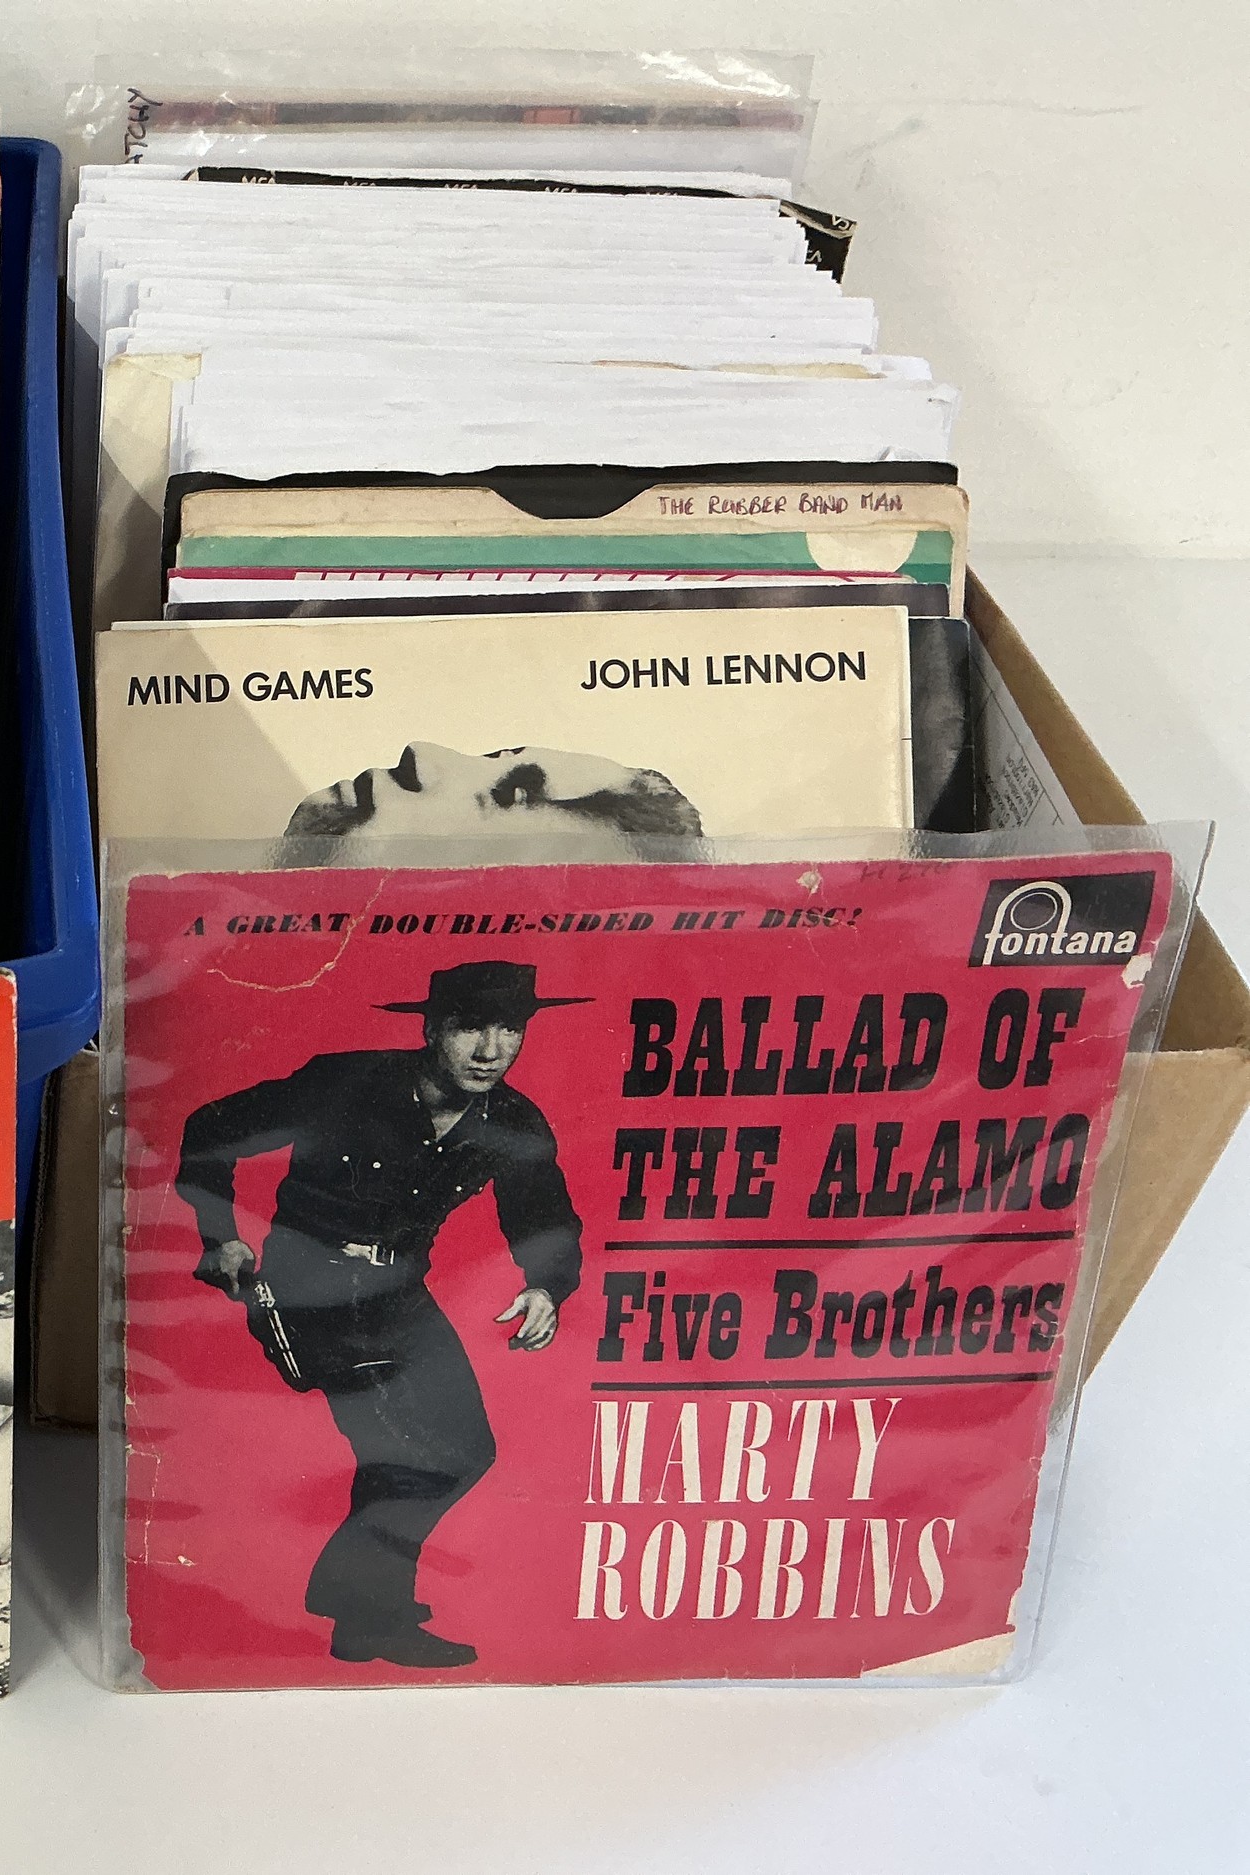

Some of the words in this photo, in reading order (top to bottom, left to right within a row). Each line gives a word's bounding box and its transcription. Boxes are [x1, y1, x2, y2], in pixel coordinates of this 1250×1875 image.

[657, 496, 694, 515] THE
[708, 494, 787, 515] RUBBER
[798, 492, 848, 514] BAND
[860, 491, 903, 512] MAN
[127, 674, 230, 708] MIND
[241, 667, 374, 702] GAMES
[580, 657, 690, 691] JOHN
[705, 650, 867, 686] LENNON
[183, 914, 206, 937] A
[226, 911, 350, 935] GREAT
[368, 907, 656, 936] DOUBLE-SIDED
[671, 909, 745, 932] HIT
[757, 906, 863, 930] DISC!
[622, 992, 949, 1098] BALLAD
[977, 987, 1086, 1090] OF
[612, 1125, 782, 1221] THE
[807, 1112, 1092, 1220] ALAMO
[596, 1271, 744, 1362] Five
[764, 1264, 1066, 1360] Brothers
[583, 1397, 903, 1505] MARTY
[572, 1518, 956, 1620] ROBBINS
